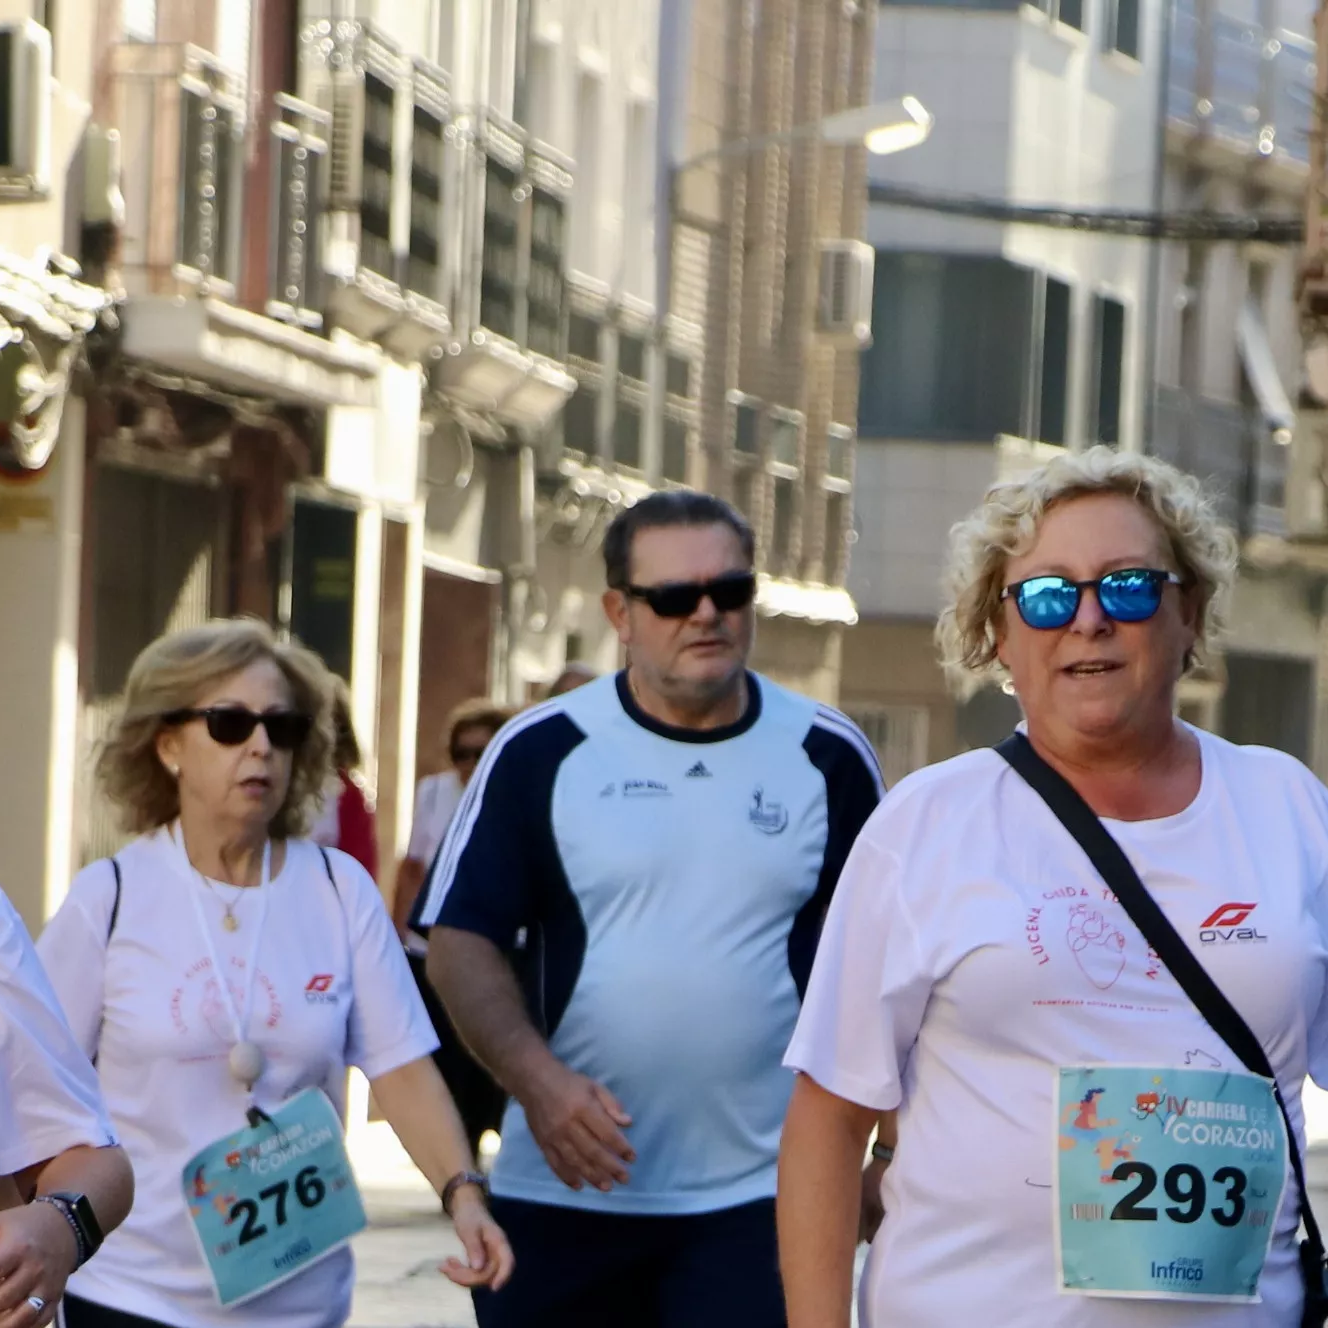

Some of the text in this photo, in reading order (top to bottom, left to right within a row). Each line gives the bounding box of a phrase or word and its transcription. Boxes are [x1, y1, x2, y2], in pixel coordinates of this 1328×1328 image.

[1026, 907, 1050, 966] LUCENA
[1166, 1095, 1188, 1117] IV
[1187, 1099, 1247, 1122] CARRERA
[1173, 1119, 1276, 1150] CORAZÓN
[229, 1165, 326, 1246] 276
[1109, 1160, 1248, 1227] 293
[1151, 1260, 1204, 1281] Infrico
